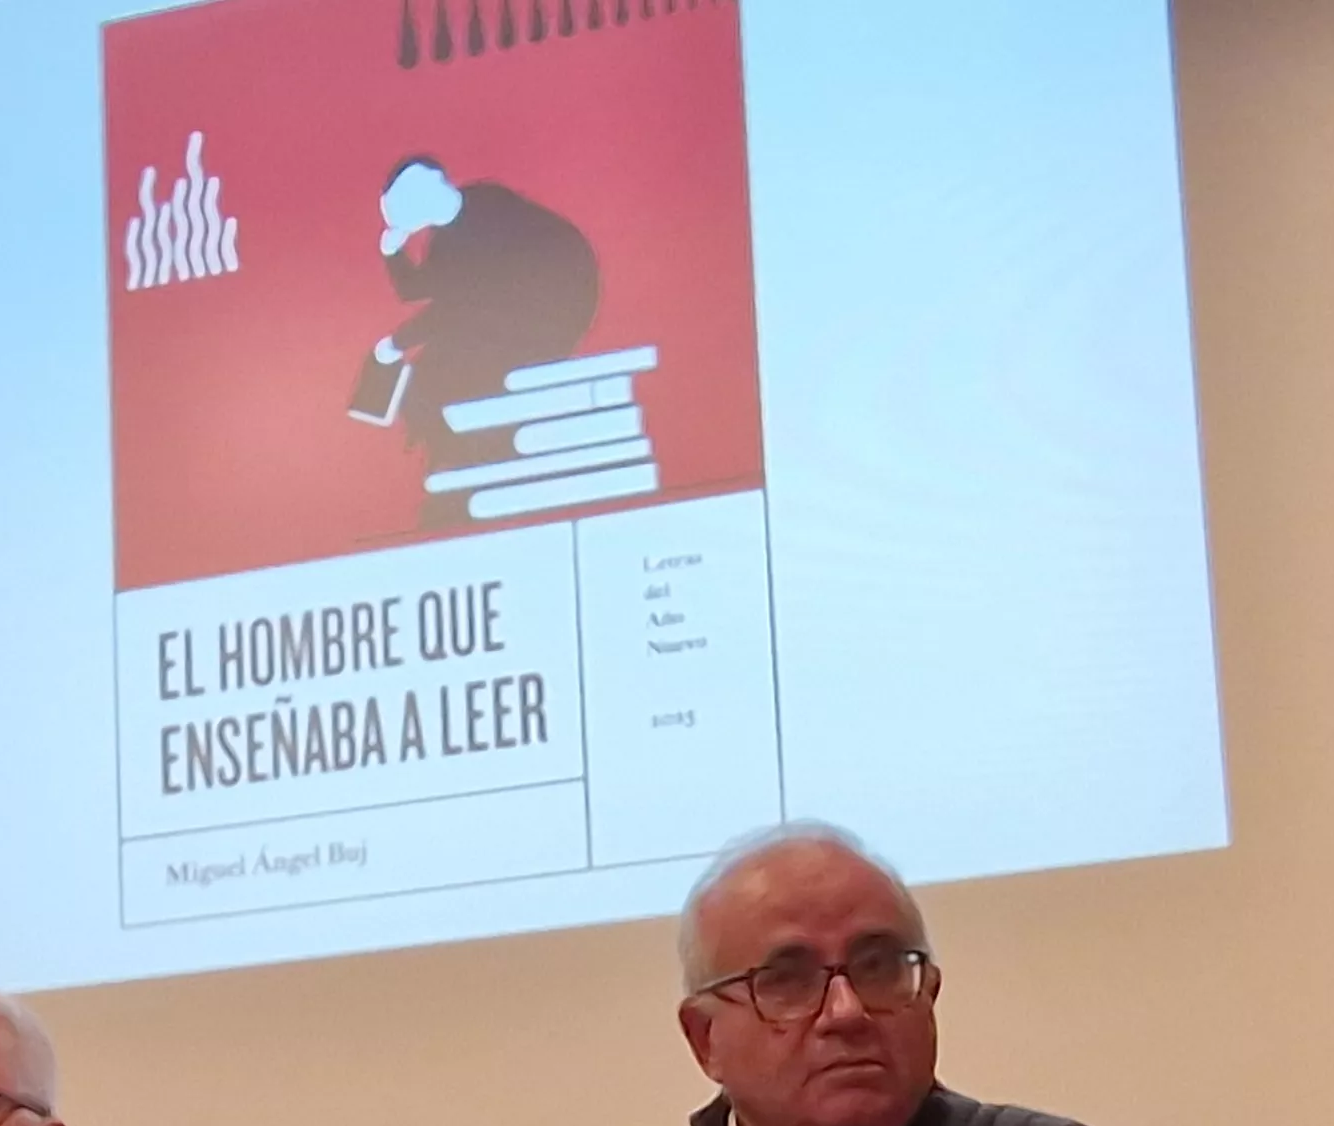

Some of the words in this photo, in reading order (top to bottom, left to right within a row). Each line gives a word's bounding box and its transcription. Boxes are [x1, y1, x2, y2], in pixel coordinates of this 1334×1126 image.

[158, 627, 205, 701] EL
[219, 597, 403, 691] HOMBRE
[418, 581, 505, 659] QUE
[161, 694, 387, 796] ENSEÑABA
[399, 690, 427, 761] A
[441, 672, 549, 756] LEER
[166, 853, 246, 888] Miguel
[252, 843, 320, 875] Ángel
[328, 839, 367, 867] Buj
